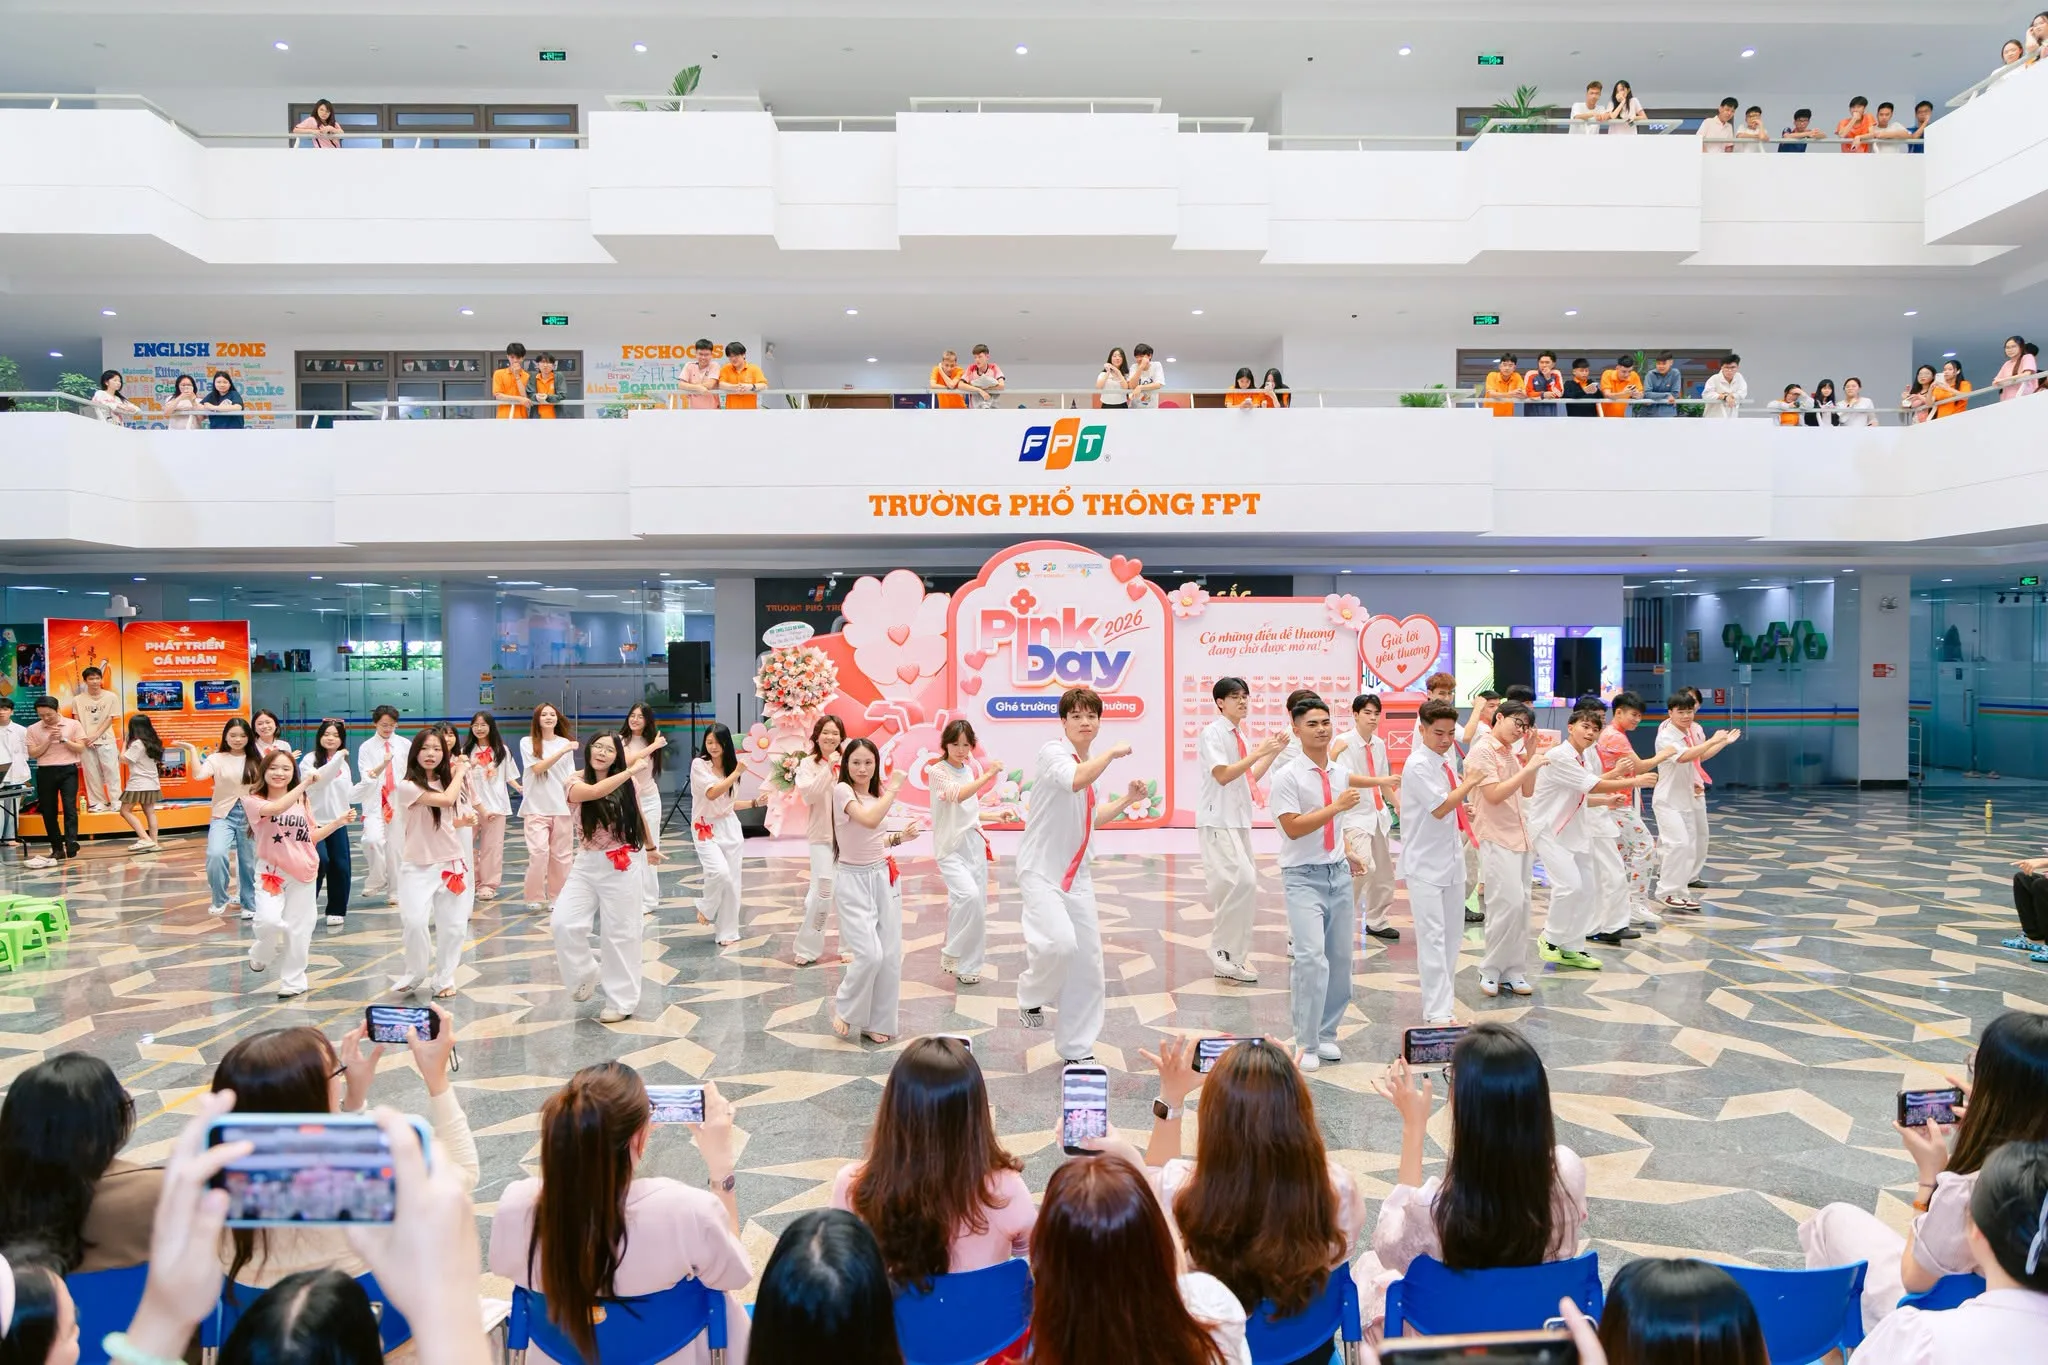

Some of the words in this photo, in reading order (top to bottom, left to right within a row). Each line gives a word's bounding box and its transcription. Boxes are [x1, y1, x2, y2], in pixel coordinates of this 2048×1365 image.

[134, 342, 210, 358] ENGLISH
[215, 342, 266, 358] ZONE
[869, 489, 1001, 516] TRƯỜNG
[1009, 486, 1075, 516] PHỔ
[1083, 488, 1195, 516] THÔNG
[1201, 493, 1261, 515] FPT
[980, 588, 1100, 648] Pink
[1103, 609, 1144, 639] 2026
[145, 639, 183, 651] PHÁT
[184, 636, 225, 651] TRIỂN
[1199, 631, 1216, 645] Có
[1218, 630, 1253, 646] những
[1254, 628, 1277, 641] điều
[1279, 626, 1293, 639] dễ
[1208, 645, 1237, 658] đang
[1306, 640, 1321, 651] ra!
[153, 653, 174, 666] CÁ
[175, 653, 217, 665] NHÂN
[1018, 645, 1132, 689] Day
[1375, 651, 1394, 668] yêu
[995, 701, 1019, 712] Ghé
[1020, 701, 1058, 713] trường
